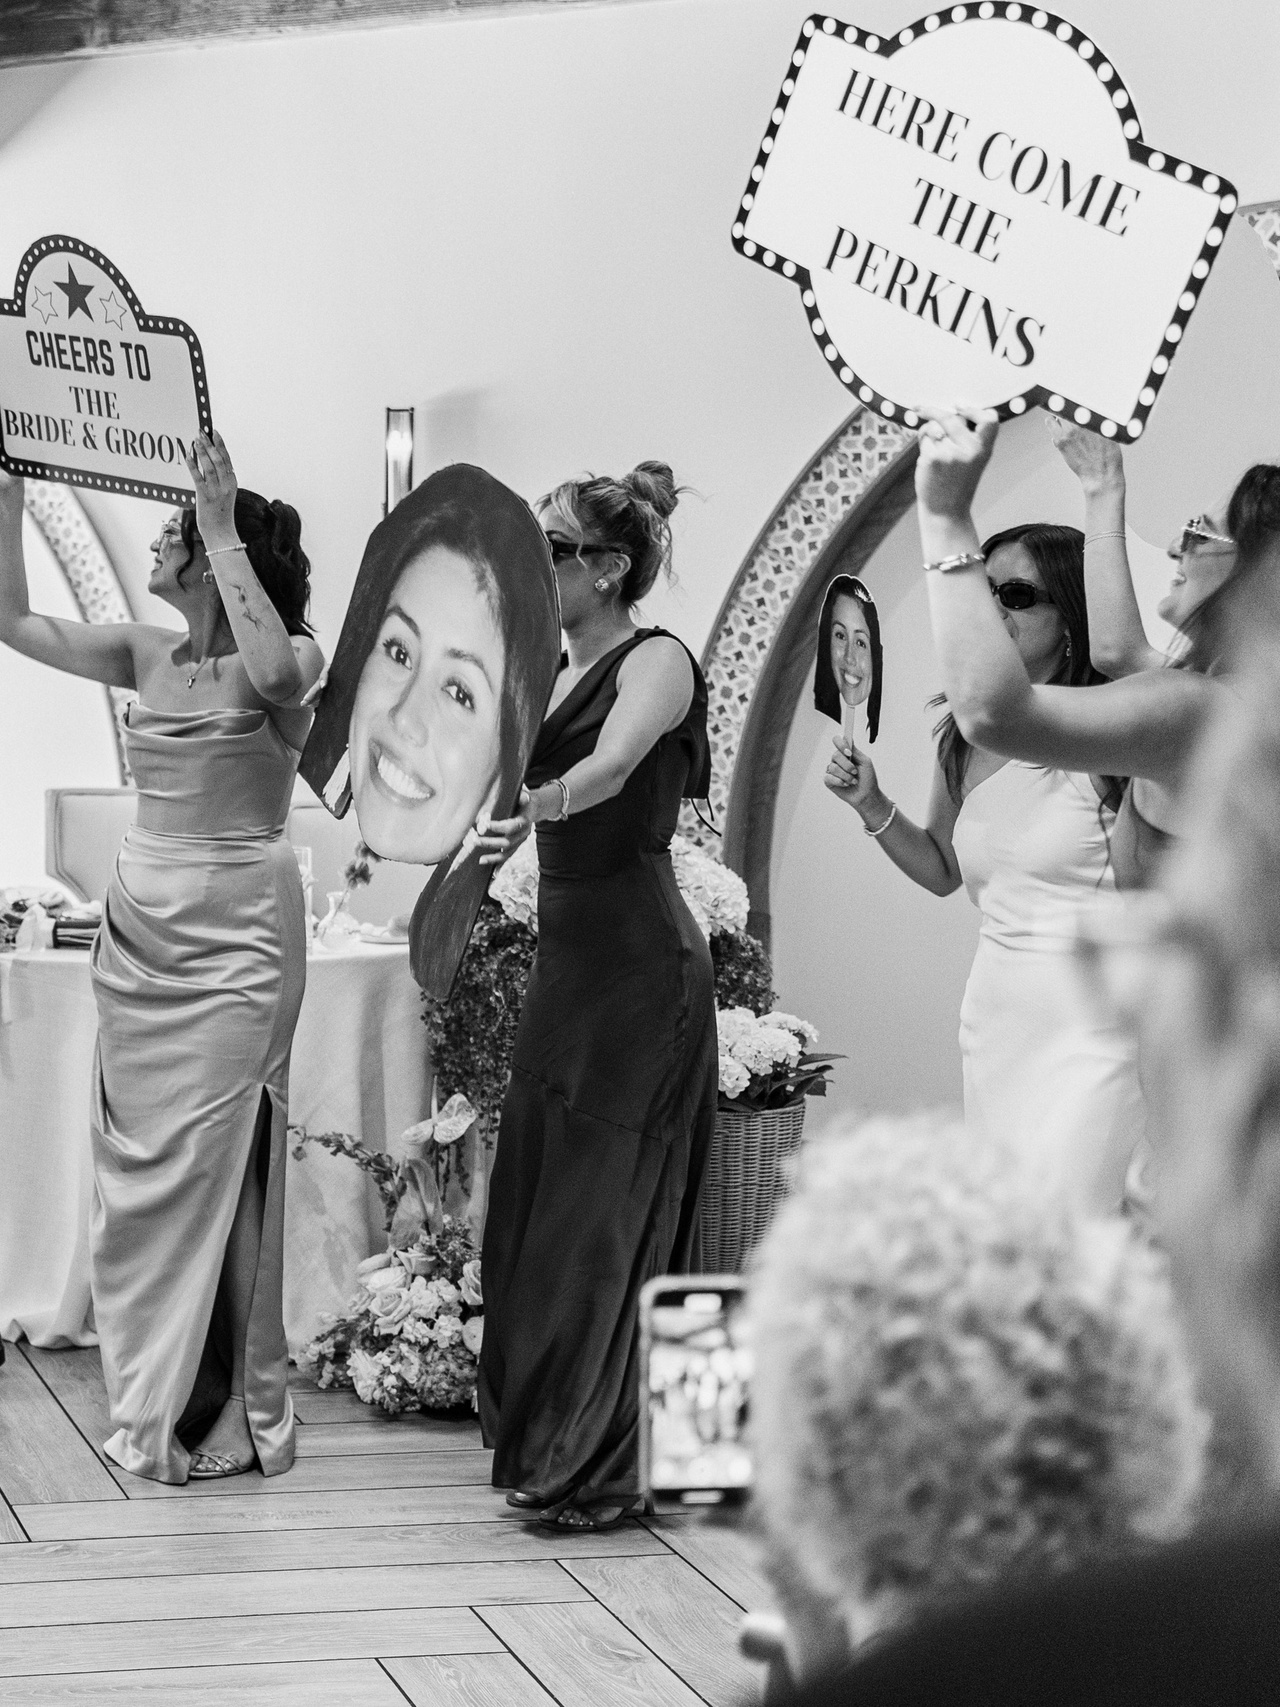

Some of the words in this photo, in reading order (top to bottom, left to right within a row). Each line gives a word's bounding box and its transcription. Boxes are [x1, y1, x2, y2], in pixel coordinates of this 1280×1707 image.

[835, 67, 970, 163] HERE
[978, 131, 1141, 237] COME
[908, 177, 1012, 263] THE
[821, 225, 1046, 367] PERKINS
[25, 330, 115, 377] CHEERS
[119, 341, 151, 382] TO
[3, 408, 76, 447] BRIDE
[82, 421, 99, 451] &
[68, 385, 120, 420] THE
